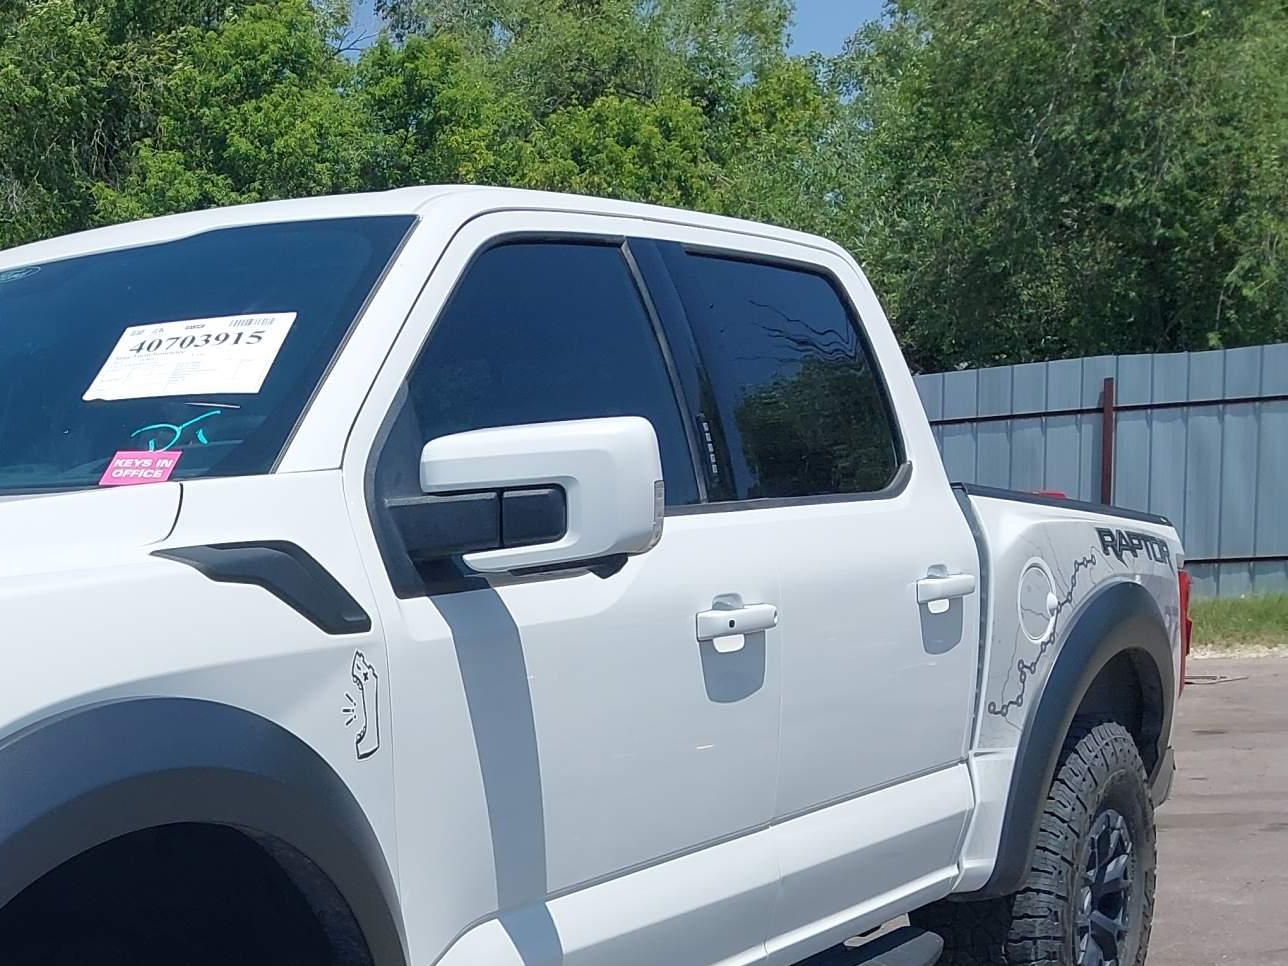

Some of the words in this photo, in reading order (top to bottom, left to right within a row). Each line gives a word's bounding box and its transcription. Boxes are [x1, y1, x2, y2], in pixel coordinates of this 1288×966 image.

[128, 330, 266, 354] 40703915
[113, 458, 152, 468] KEYS
[155, 458, 174, 468] IN
[112, 468, 164, 478] OFFICE
[1095, 527, 1175, 573] RAPTOR
